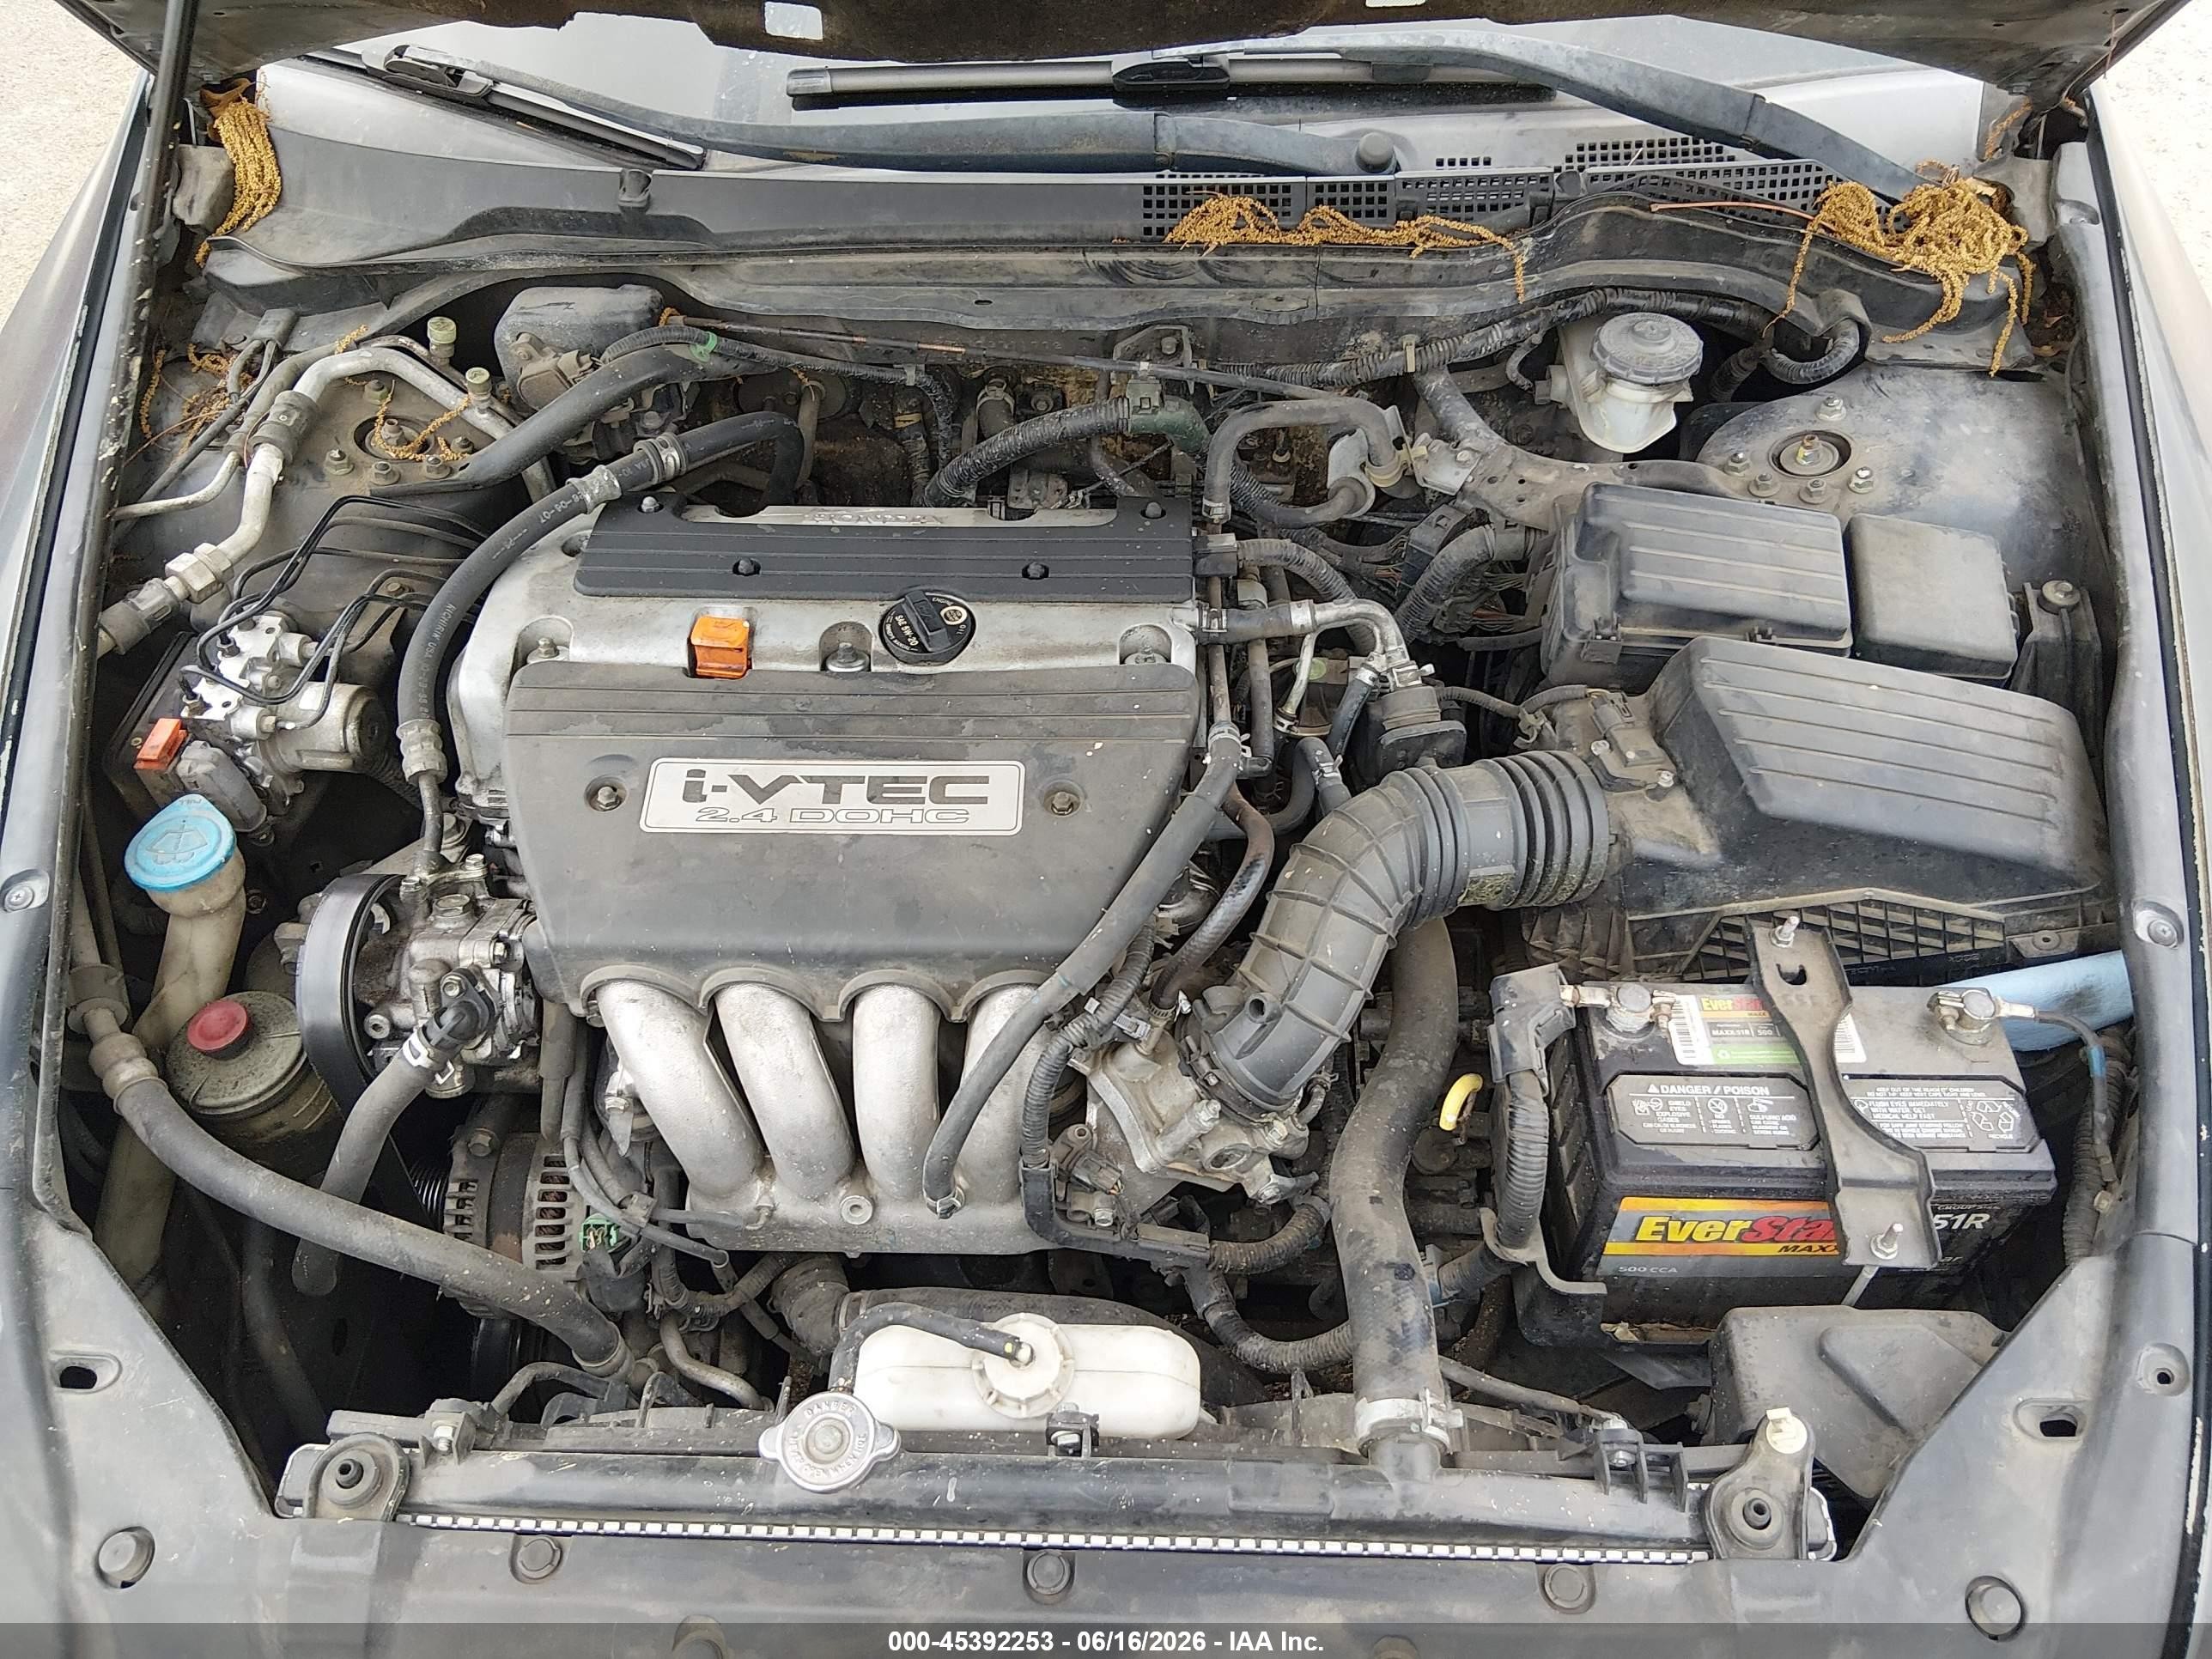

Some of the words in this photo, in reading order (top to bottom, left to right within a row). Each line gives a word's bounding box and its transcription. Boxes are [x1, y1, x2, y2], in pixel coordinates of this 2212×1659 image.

[895, 615, 907, 627] SAE
[901, 626, 920, 646] 5W-20
[422, 641, 437, 659] USA
[683, 769, 990, 805] i-VTEC
[696, 807, 778, 823] 2.4
[789, 808, 970, 824] DOHC
[1701, 998, 1764, 1011] EverStar
[1660, 1085, 1712, 1094] DANGER
[1723, 1085, 1771, 1096] POISON
[1635, 1215, 1836, 1243] EverSta
[1933, 1213, 1990, 1230] 51R
[804, 1401, 858, 1419] DANGER
